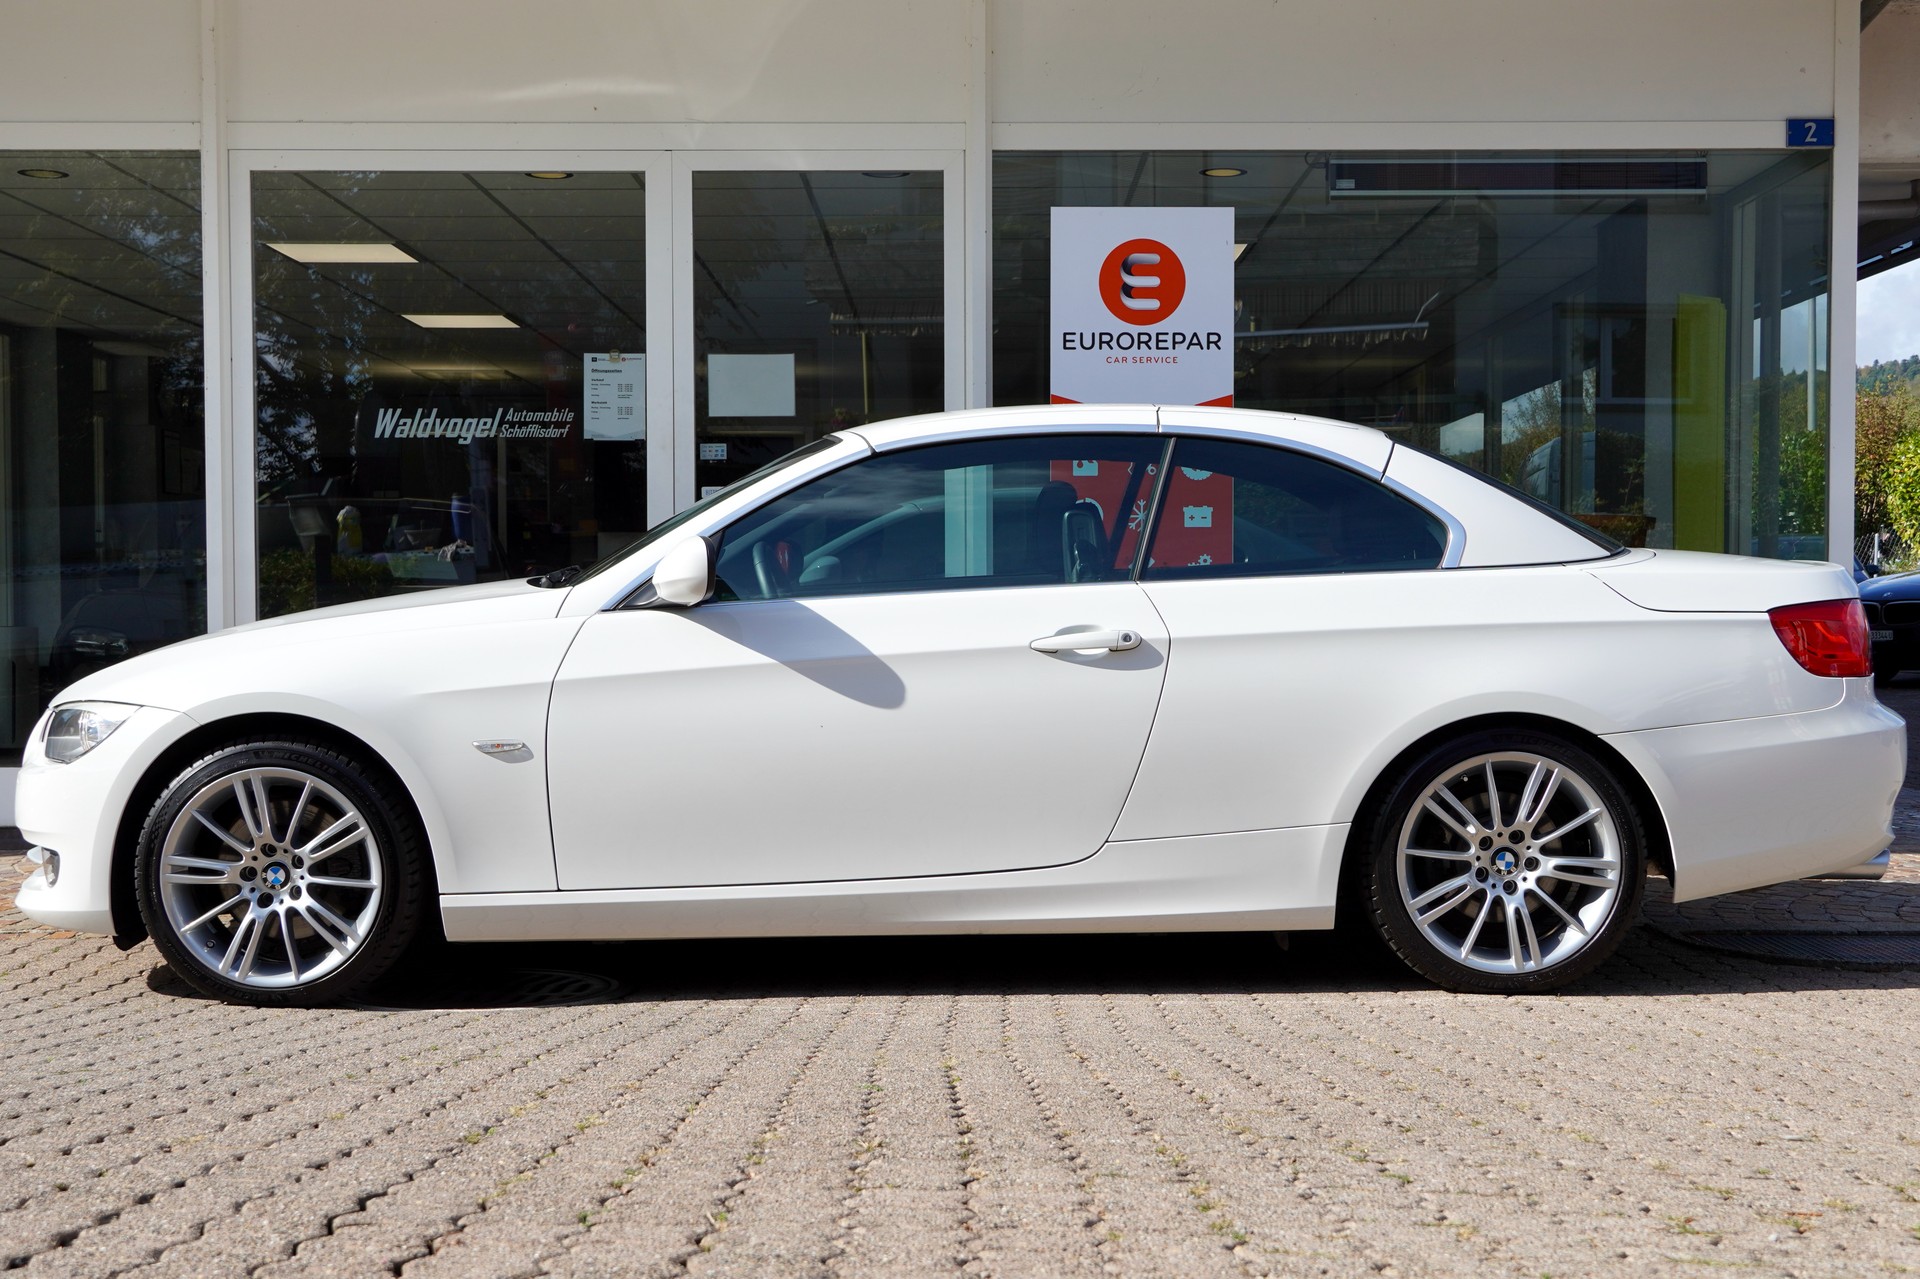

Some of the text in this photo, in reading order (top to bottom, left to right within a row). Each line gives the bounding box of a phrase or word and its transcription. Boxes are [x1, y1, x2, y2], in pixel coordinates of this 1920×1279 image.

[1804, 122, 1818, 143] 2
[1062, 332, 1222, 350] EUROREPAR
[1106, 356, 1179, 364] CAR SERVICE
[374, 408, 575, 444] Waldvogel Automobile
[499, 424, 571, 438] Schöfflisdorf
